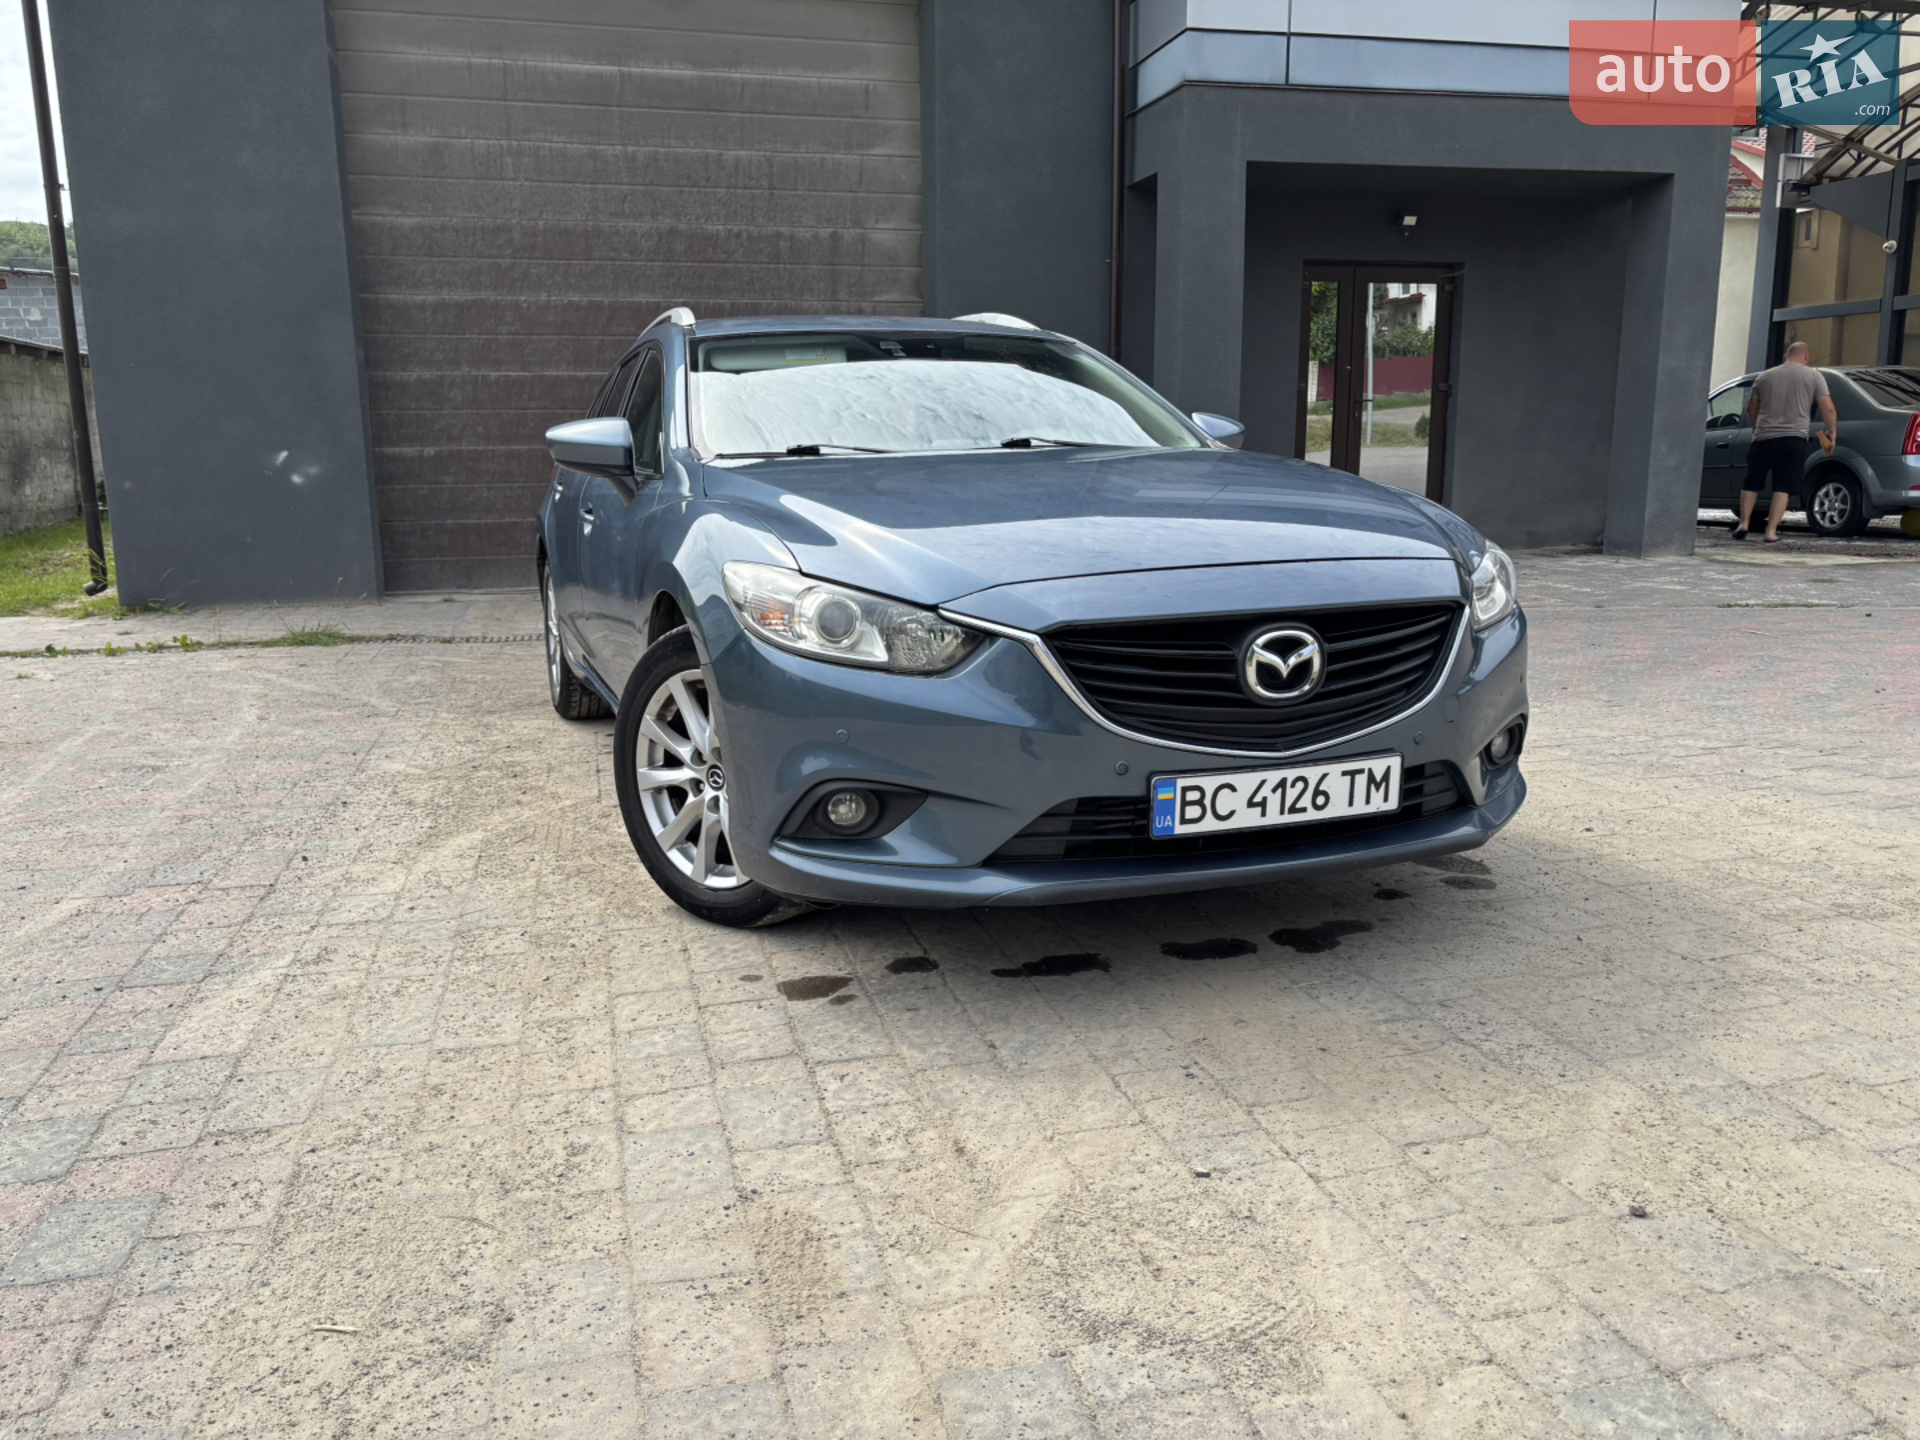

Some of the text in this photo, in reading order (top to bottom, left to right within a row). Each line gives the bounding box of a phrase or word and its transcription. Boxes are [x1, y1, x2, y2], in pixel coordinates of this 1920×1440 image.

[1179, 765, 1391, 826] BC 4126 TM
[1155, 815, 1173, 828] UA
